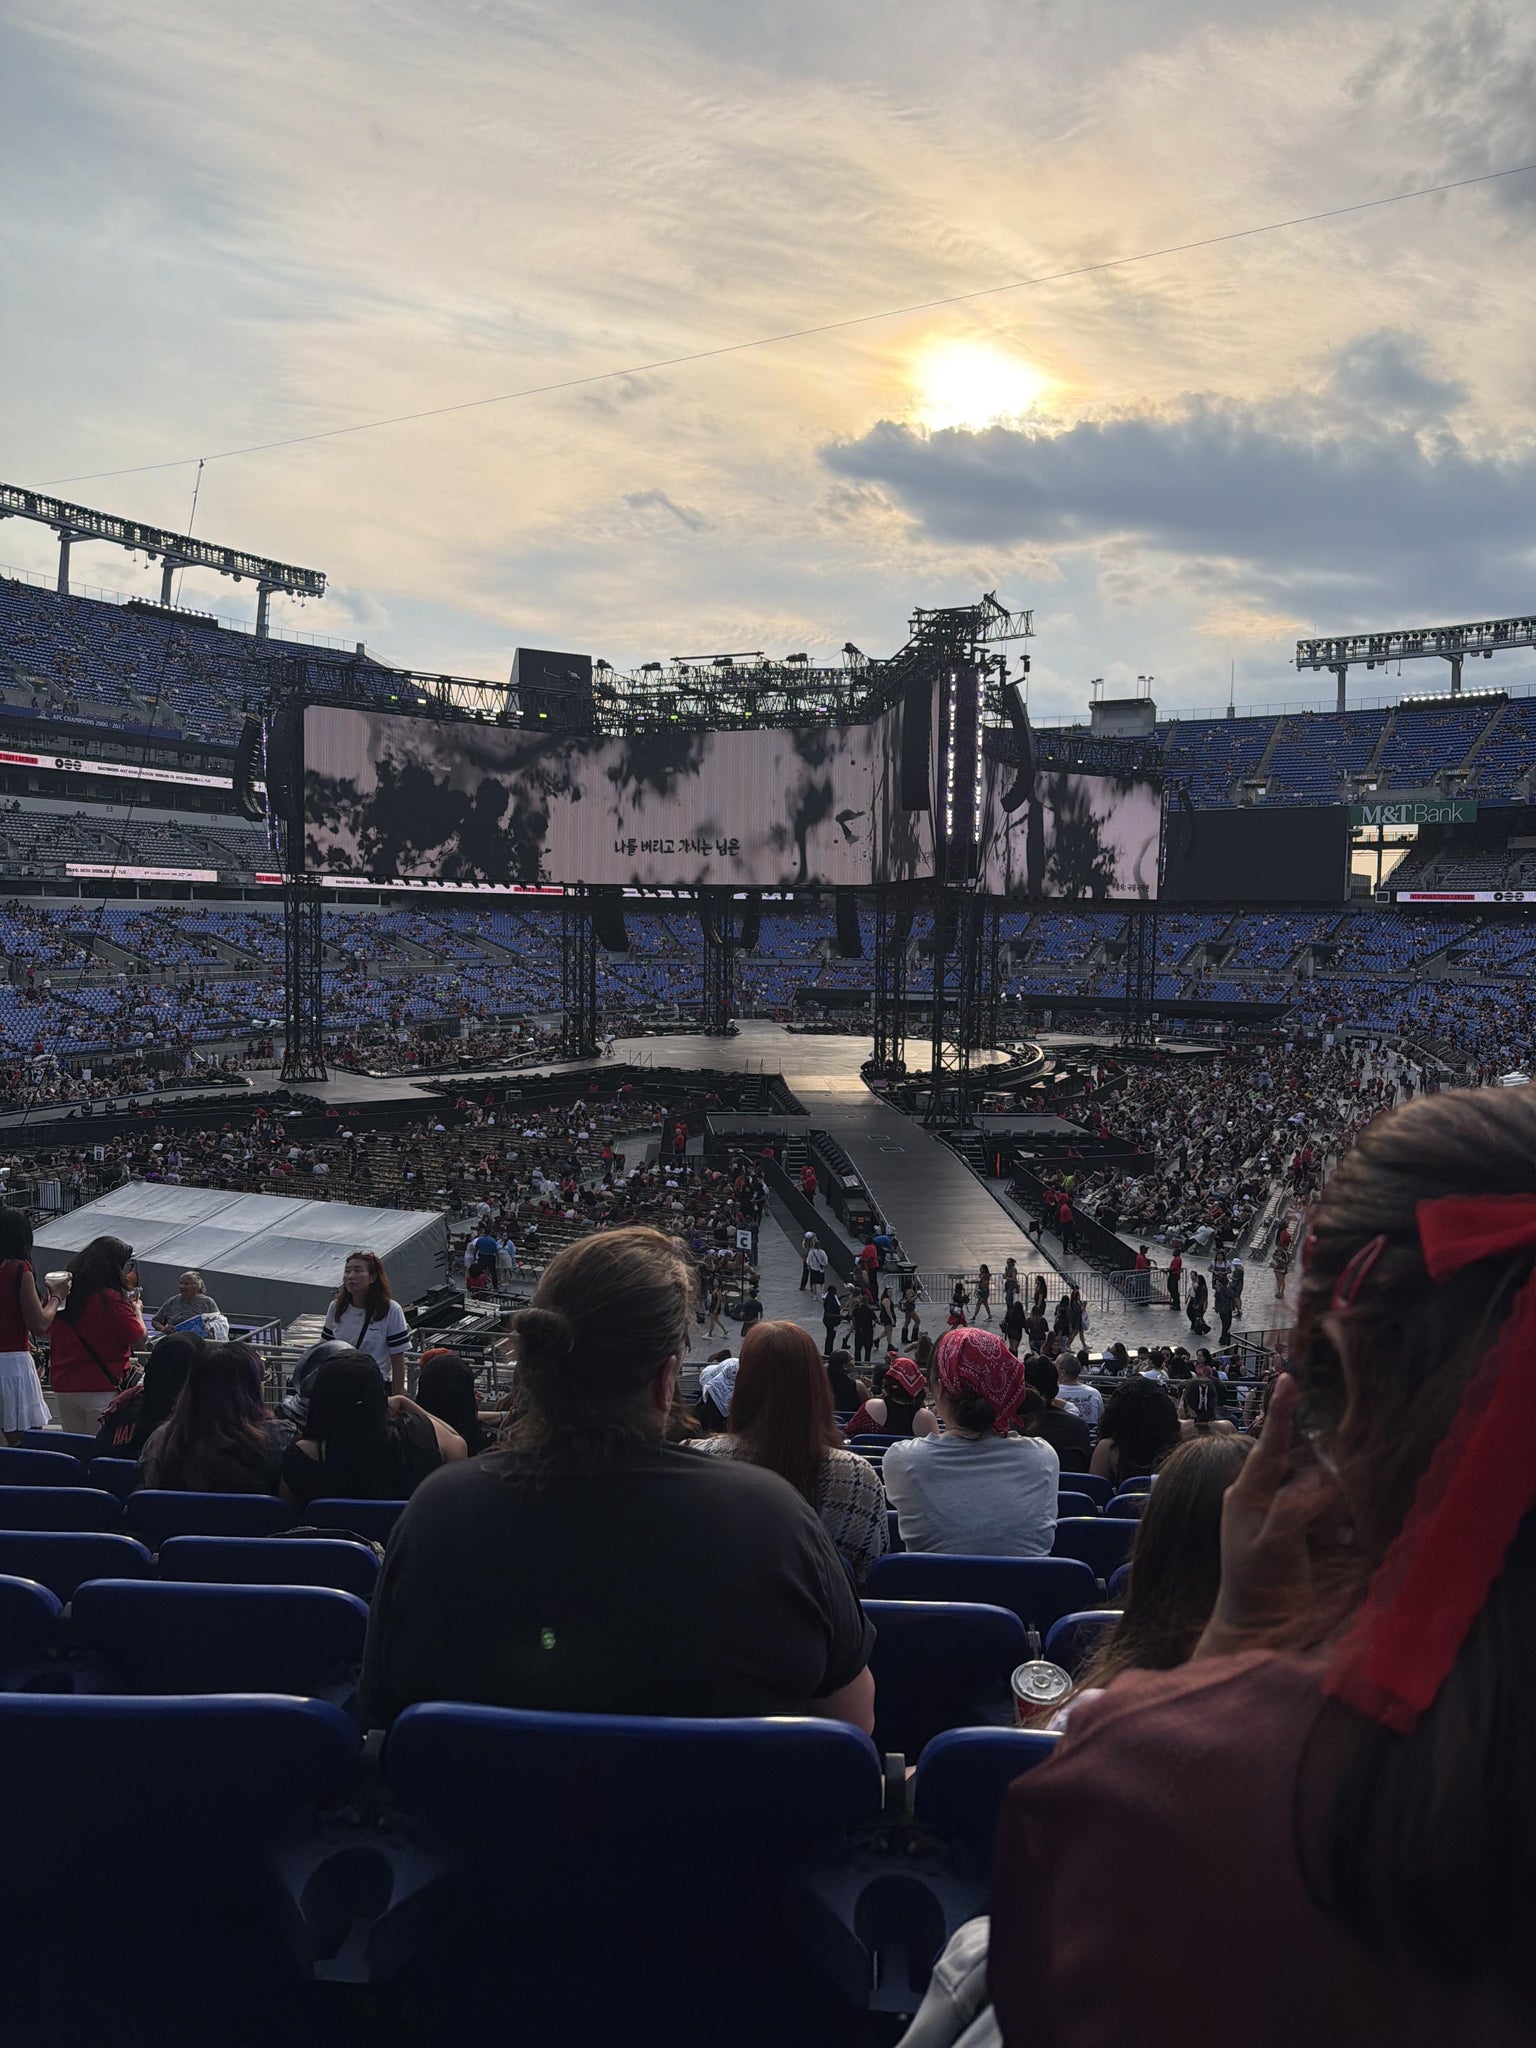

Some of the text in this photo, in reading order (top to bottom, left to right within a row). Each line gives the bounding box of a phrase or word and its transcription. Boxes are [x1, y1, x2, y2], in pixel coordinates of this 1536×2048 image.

[63, 716, 95, 726] CHAMPIONS
[111, 722, 125, 730] 2012
[1361, 802, 1464, 825] M&T Bank
[614, 838, 740, 857] 나를 버리고 가시는 님은
[95, 1150, 102, 1160] B
[740, 1236, 748, 1248] C
